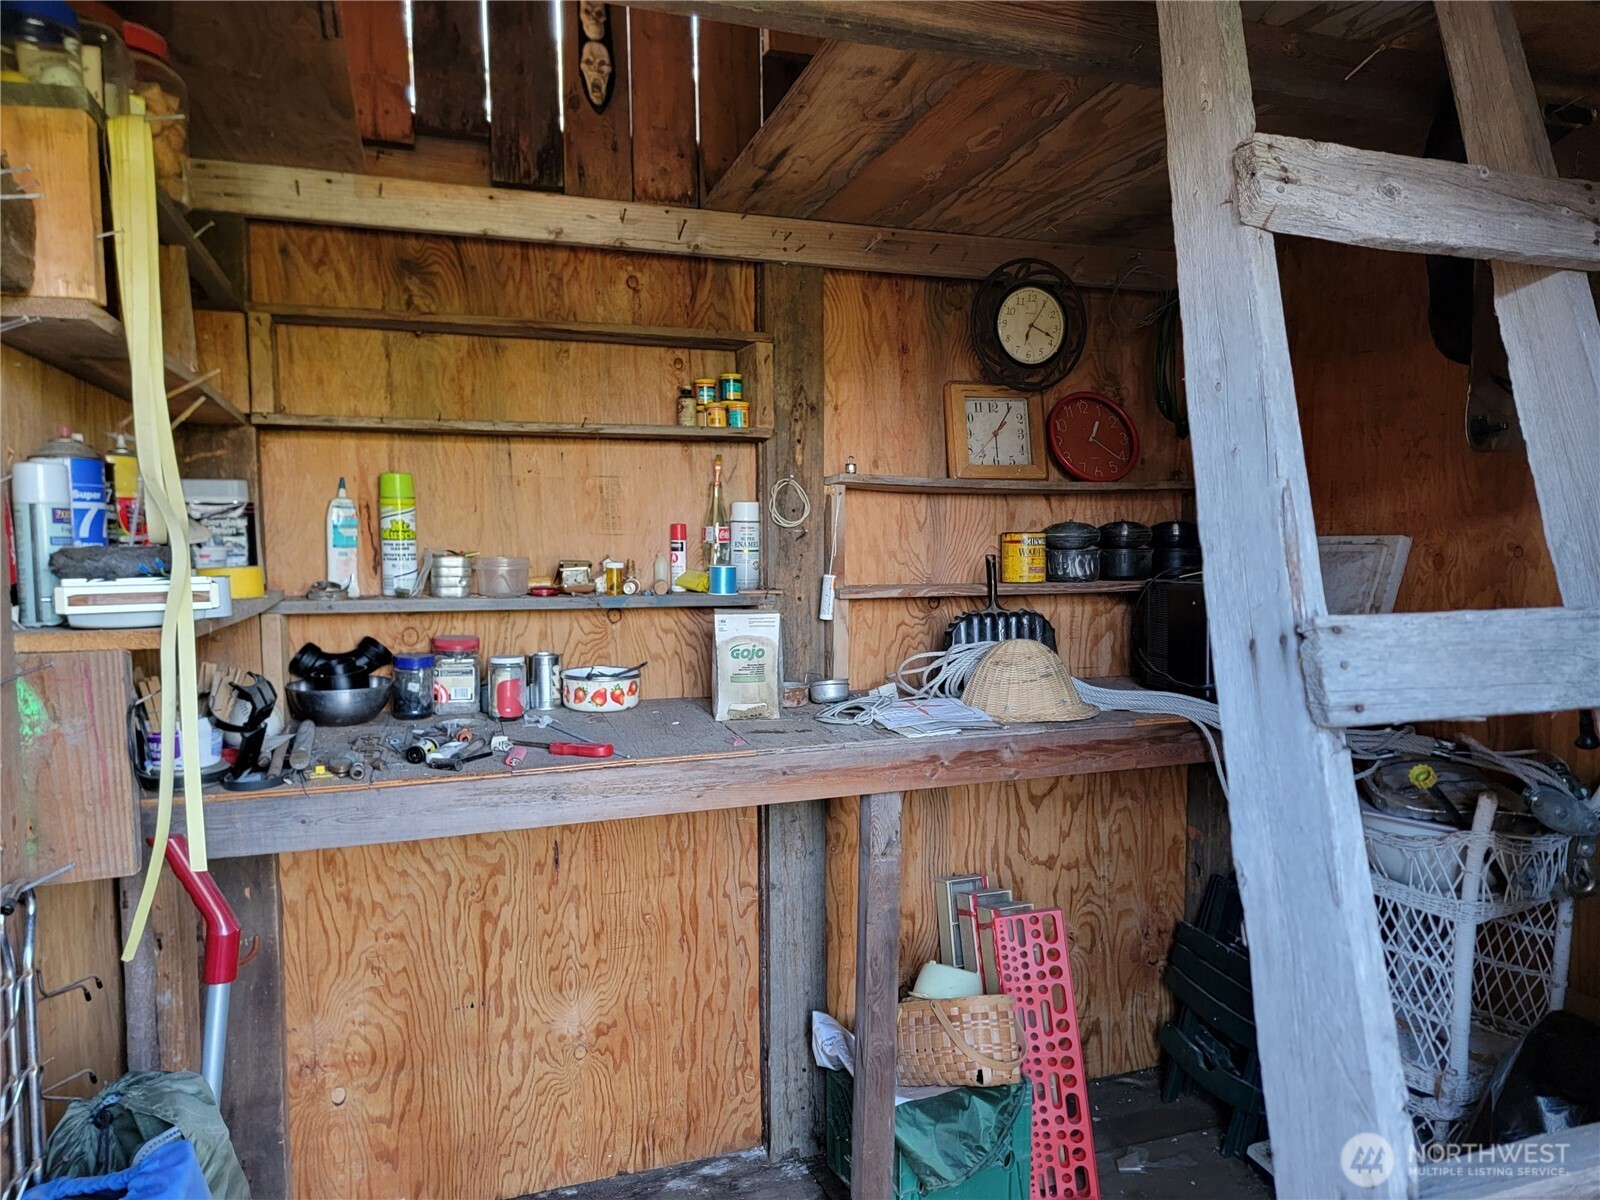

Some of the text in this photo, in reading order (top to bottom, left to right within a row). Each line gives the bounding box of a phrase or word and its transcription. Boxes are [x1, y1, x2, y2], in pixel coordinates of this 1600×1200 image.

[1016, 297, 1025, 306] 11
[1027, 293, 1038, 303] 12
[1006, 307, 1016, 316] 10
[1050, 310, 1057, 319] 2
[1002, 319, 1008, 328] 9
[1053, 324, 1059, 334] 3
[1005, 334, 1011, 343] 8
[1047, 340, 1054, 348] 4
[1015, 345, 1021, 354] 7
[1025, 350, 1032, 359] 6
[1038, 347, 1045, 356] 5
[974, 402, 983, 413] 11
[987, 402, 999, 413] 12
[1063, 405, 1074, 418] 11
[1076, 400, 1089, 414] 12
[1016, 413, 1024, 424] 2
[1108, 416, 1118, 429] 2
[1055, 418, 1068, 432] 10
[1017, 428, 1025, 440] 3
[1119, 432, 1128, 446] 3
[1019, 443, 1025, 456] 4
[1009, 455, 1016, 466] 5
[1118, 450, 1127, 462] 4
[1079, 462, 1087, 472] 7
[1108, 461, 1118, 474] 5
[71, 489, 102, 501] Super
[72, 502, 101, 538] 7
[382, 528, 417, 540] Muscl
